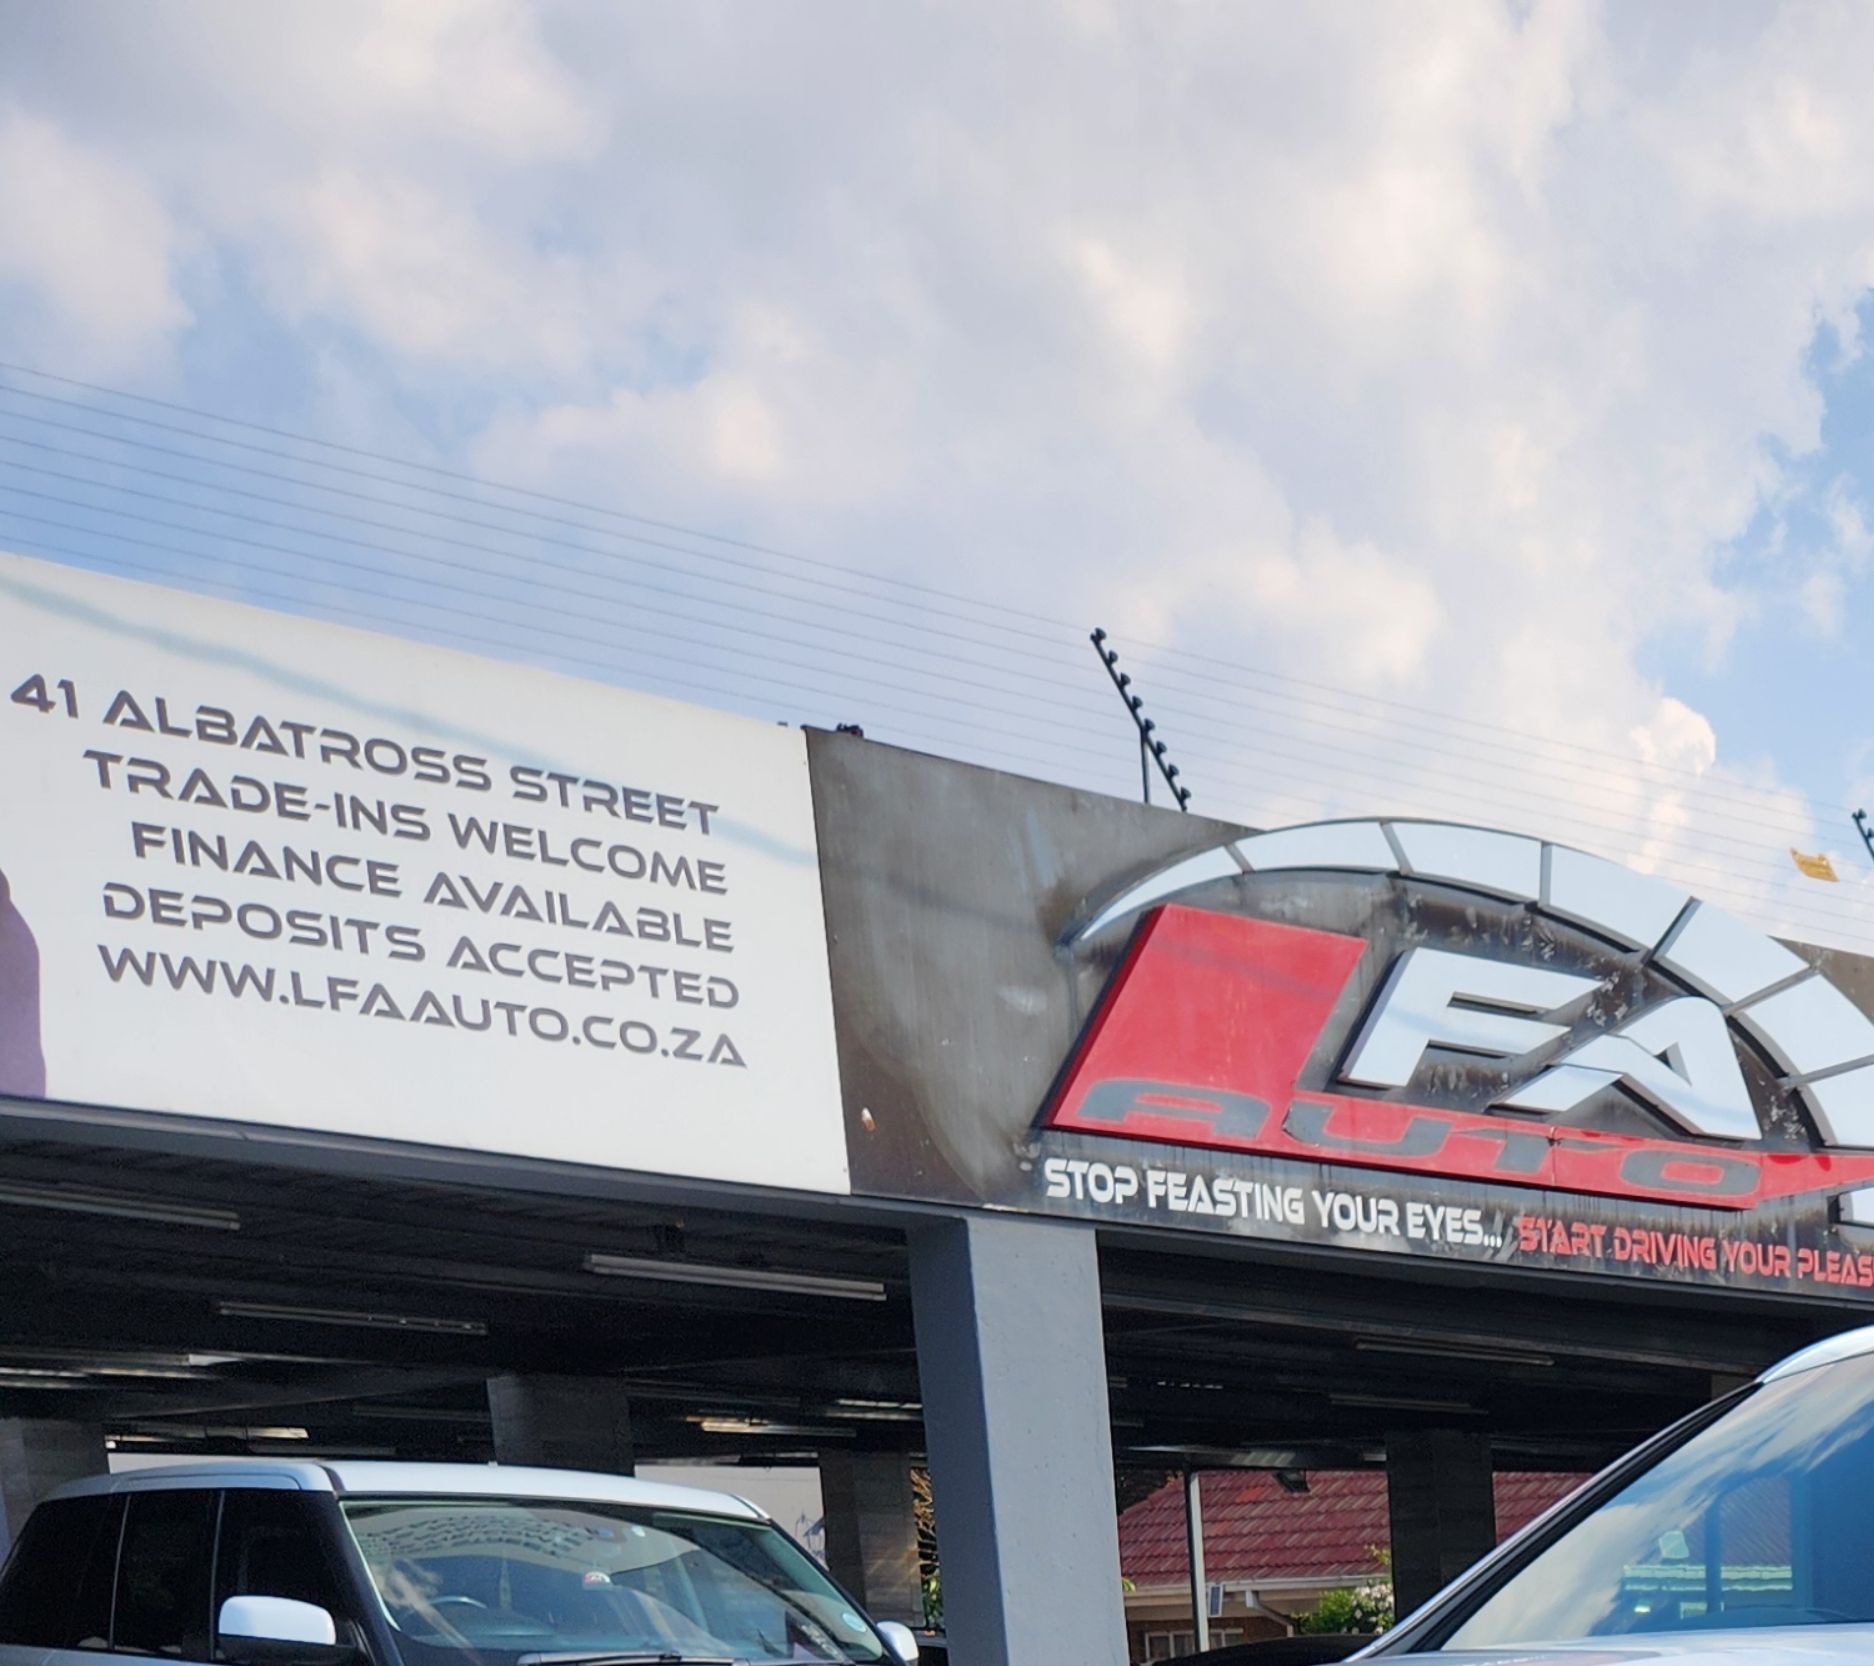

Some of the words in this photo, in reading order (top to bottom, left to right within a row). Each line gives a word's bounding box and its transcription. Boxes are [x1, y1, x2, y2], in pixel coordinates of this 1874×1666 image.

[10, 673, 80, 719] 41
[102, 688, 493, 792] ALBATROSS
[508, 765, 720, 837] STREET
[82, 748, 432, 842] TRADE-INS
[446, 812, 729, 896] WELCOME
[131, 820, 403, 899] FINANCE
[422, 870, 735, 953] AVAILABLE
[96, 942, 748, 1069] WWW.LFAAUTO.CO.ZA
[102, 881, 427, 963] DEPOSITS
[445, 935, 741, 1011] ACCEPTED
[1076, 1078, 1763, 1198] AUTO
[1043, 1157, 1140, 1204] STOP
[1146, 1167, 1306, 1227] FEASTING
[1310, 1188, 1401, 1238] YOUR
[1405, 1202, 1504, 1251] EYES...
[1517, 1215, 1609, 1258] START
[1611, 1223, 1718, 1272] DRIVING
[1718, 1236, 1792, 1280] YOUR
